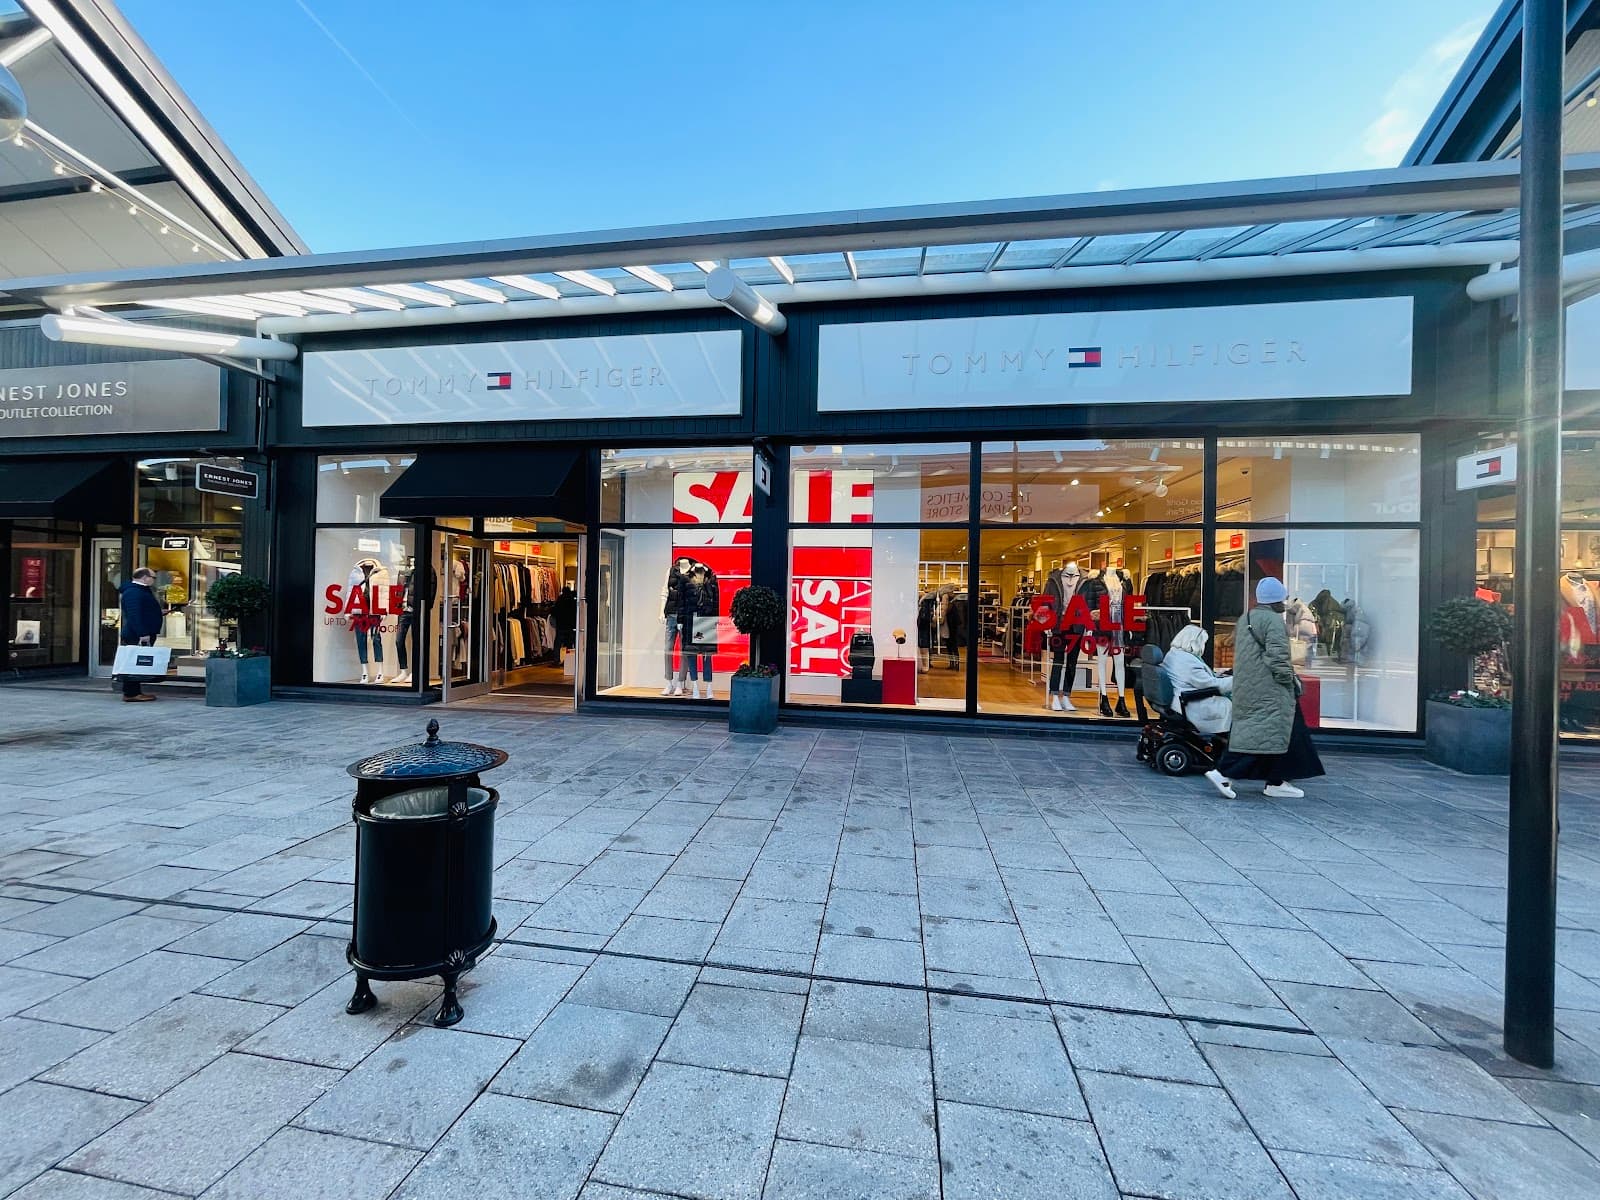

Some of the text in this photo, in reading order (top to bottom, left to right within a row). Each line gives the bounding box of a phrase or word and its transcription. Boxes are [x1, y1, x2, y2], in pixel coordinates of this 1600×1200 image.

[902, 341, 1306, 375] TOMMY HILFIGER
[57, 381, 128, 399] JONES
[365, 366, 665, 396] TOMMY HILFIGER
[40, 404, 113, 418] COLLECTION
[204, 473, 230, 482] ERNEST
[232, 478, 253, 486] JONES
[324, 584, 404, 616] SALE
[324, 617, 335, 626] UP
[1031, 594, 1147, 631] SALE
